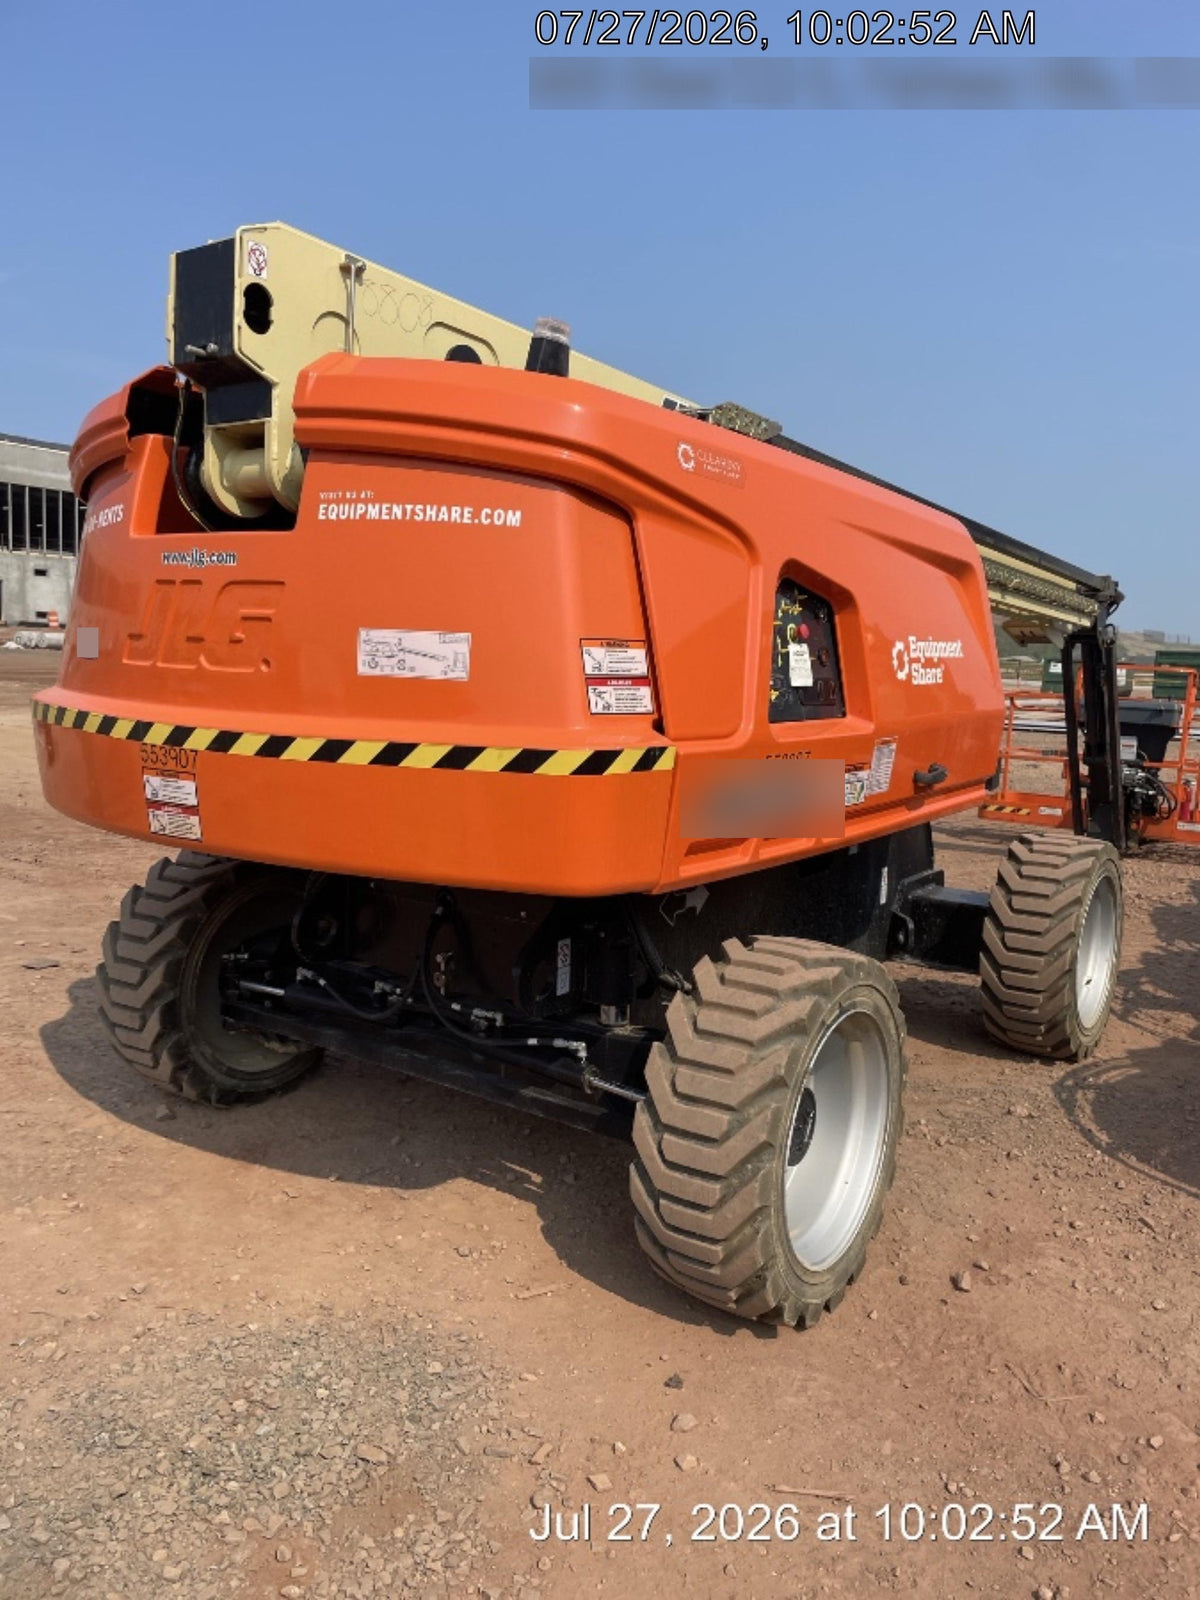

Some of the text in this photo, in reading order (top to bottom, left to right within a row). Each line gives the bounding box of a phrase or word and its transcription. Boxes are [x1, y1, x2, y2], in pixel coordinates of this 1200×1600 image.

[318, 502, 522, 527] EQUIPMENTSHARE.COM
[162, 549, 237, 567] www.jlg.com
[907, 635, 964, 663] Equipment
[911, 662, 944, 685] Share
[140, 743, 199, 770] 553907
